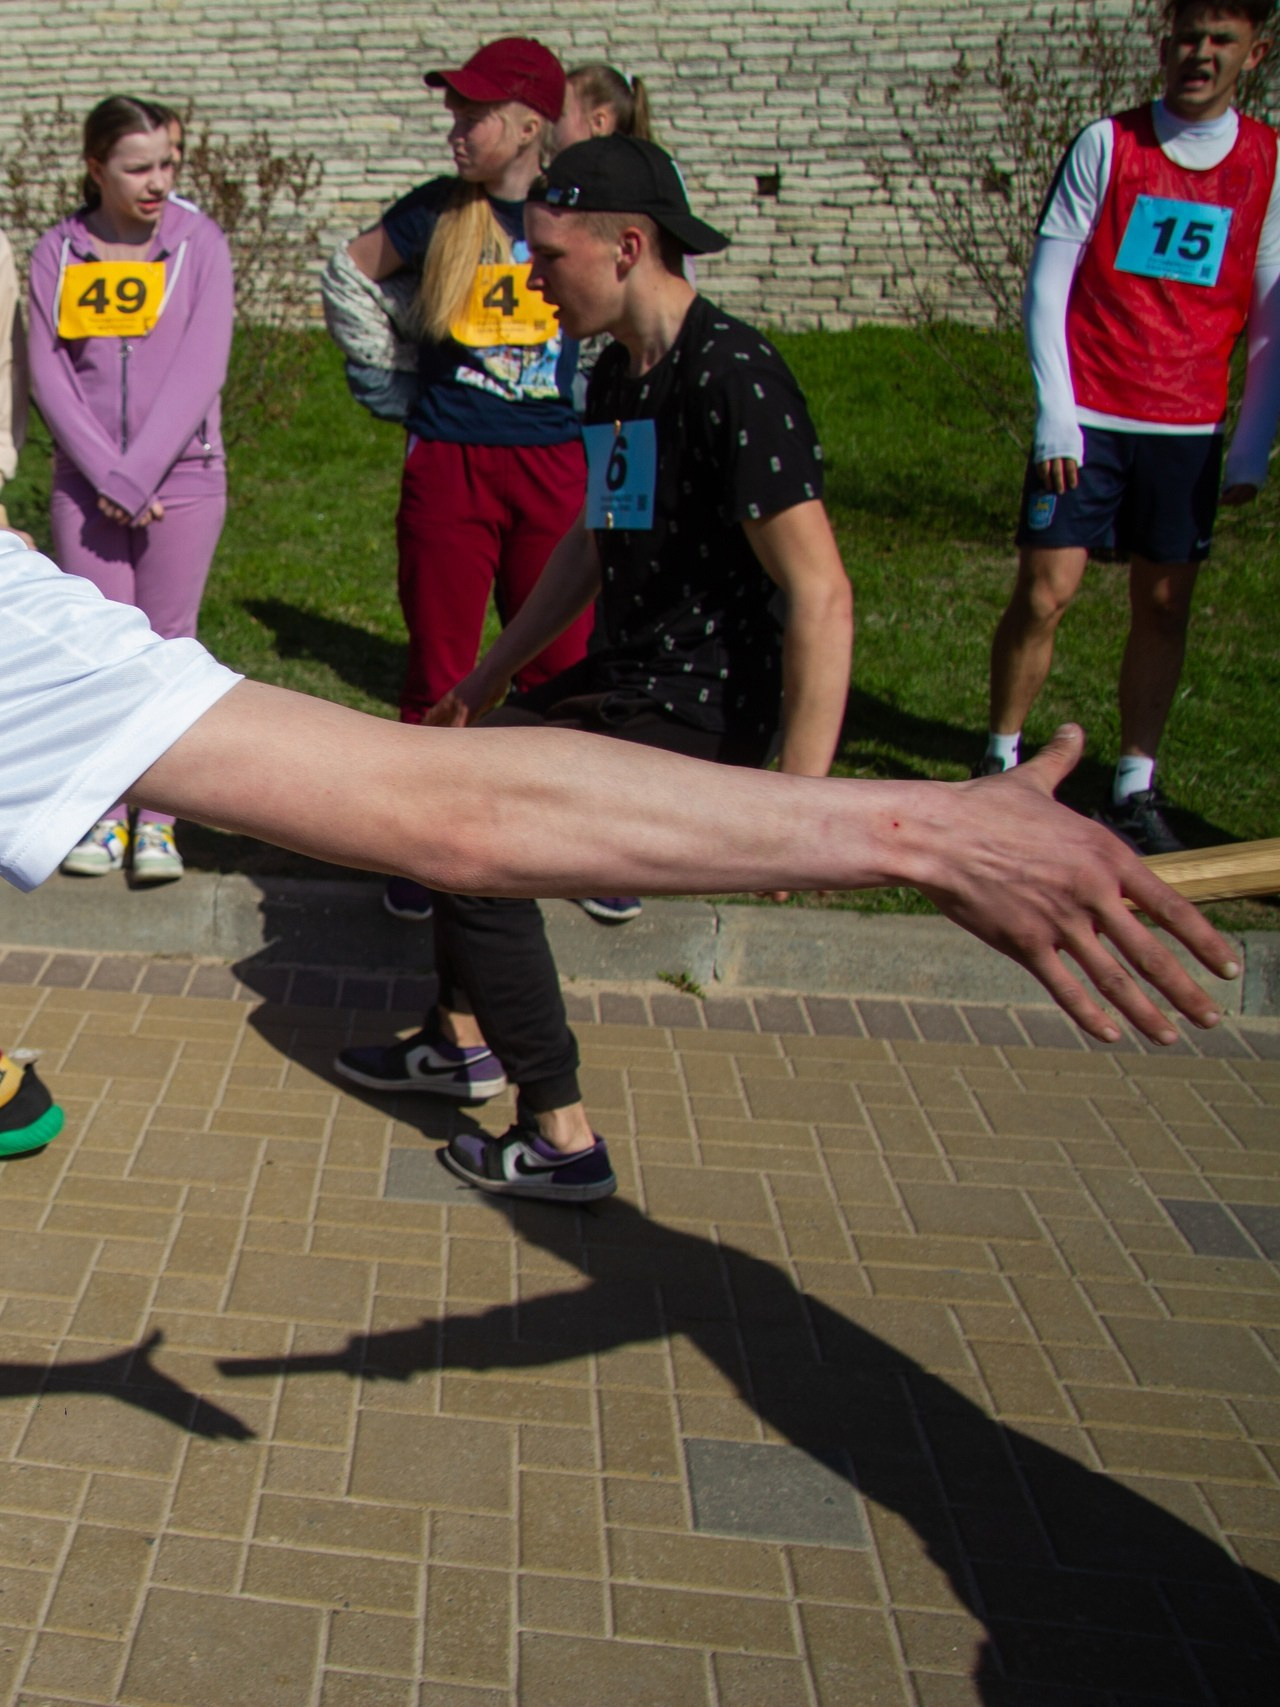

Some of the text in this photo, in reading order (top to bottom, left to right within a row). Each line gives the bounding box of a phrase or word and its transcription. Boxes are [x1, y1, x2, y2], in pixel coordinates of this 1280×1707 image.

[1152, 216, 1214, 262] 15
[78, 277, 147, 314] 49
[482, 275, 519, 316] 4
[606, 436, 627, 491] 6
